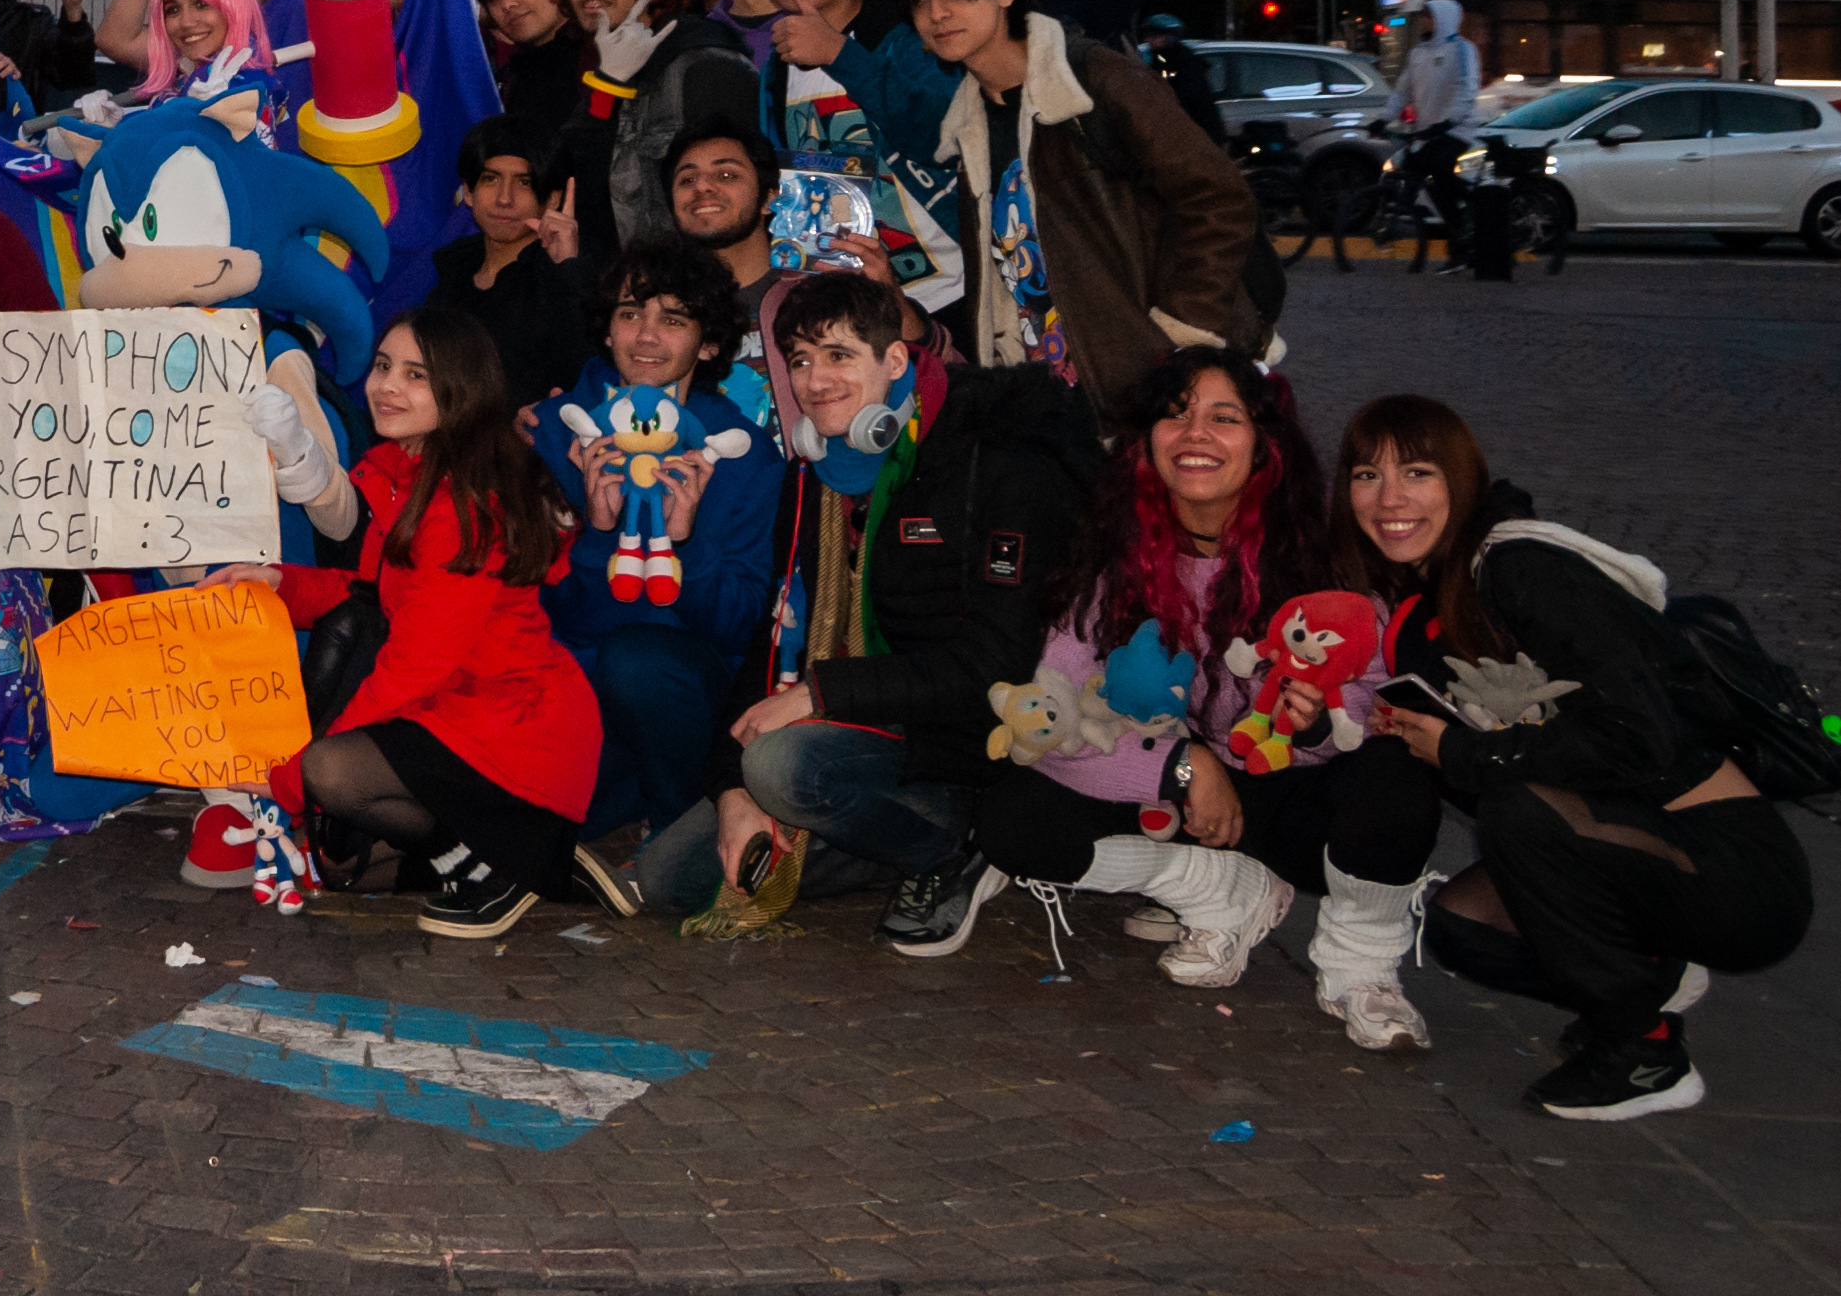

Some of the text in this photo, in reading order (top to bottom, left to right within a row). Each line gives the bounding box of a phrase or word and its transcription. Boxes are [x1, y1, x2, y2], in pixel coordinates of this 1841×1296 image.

[1, 329, 258, 394] SYMPHONY,
[8, 399, 97, 449] YOU,
[106, 403, 215, 448] COME
[141, 514, 192, 564] :3
[230, 671, 291, 706] FOR
[156, 721, 226, 755] YOU
